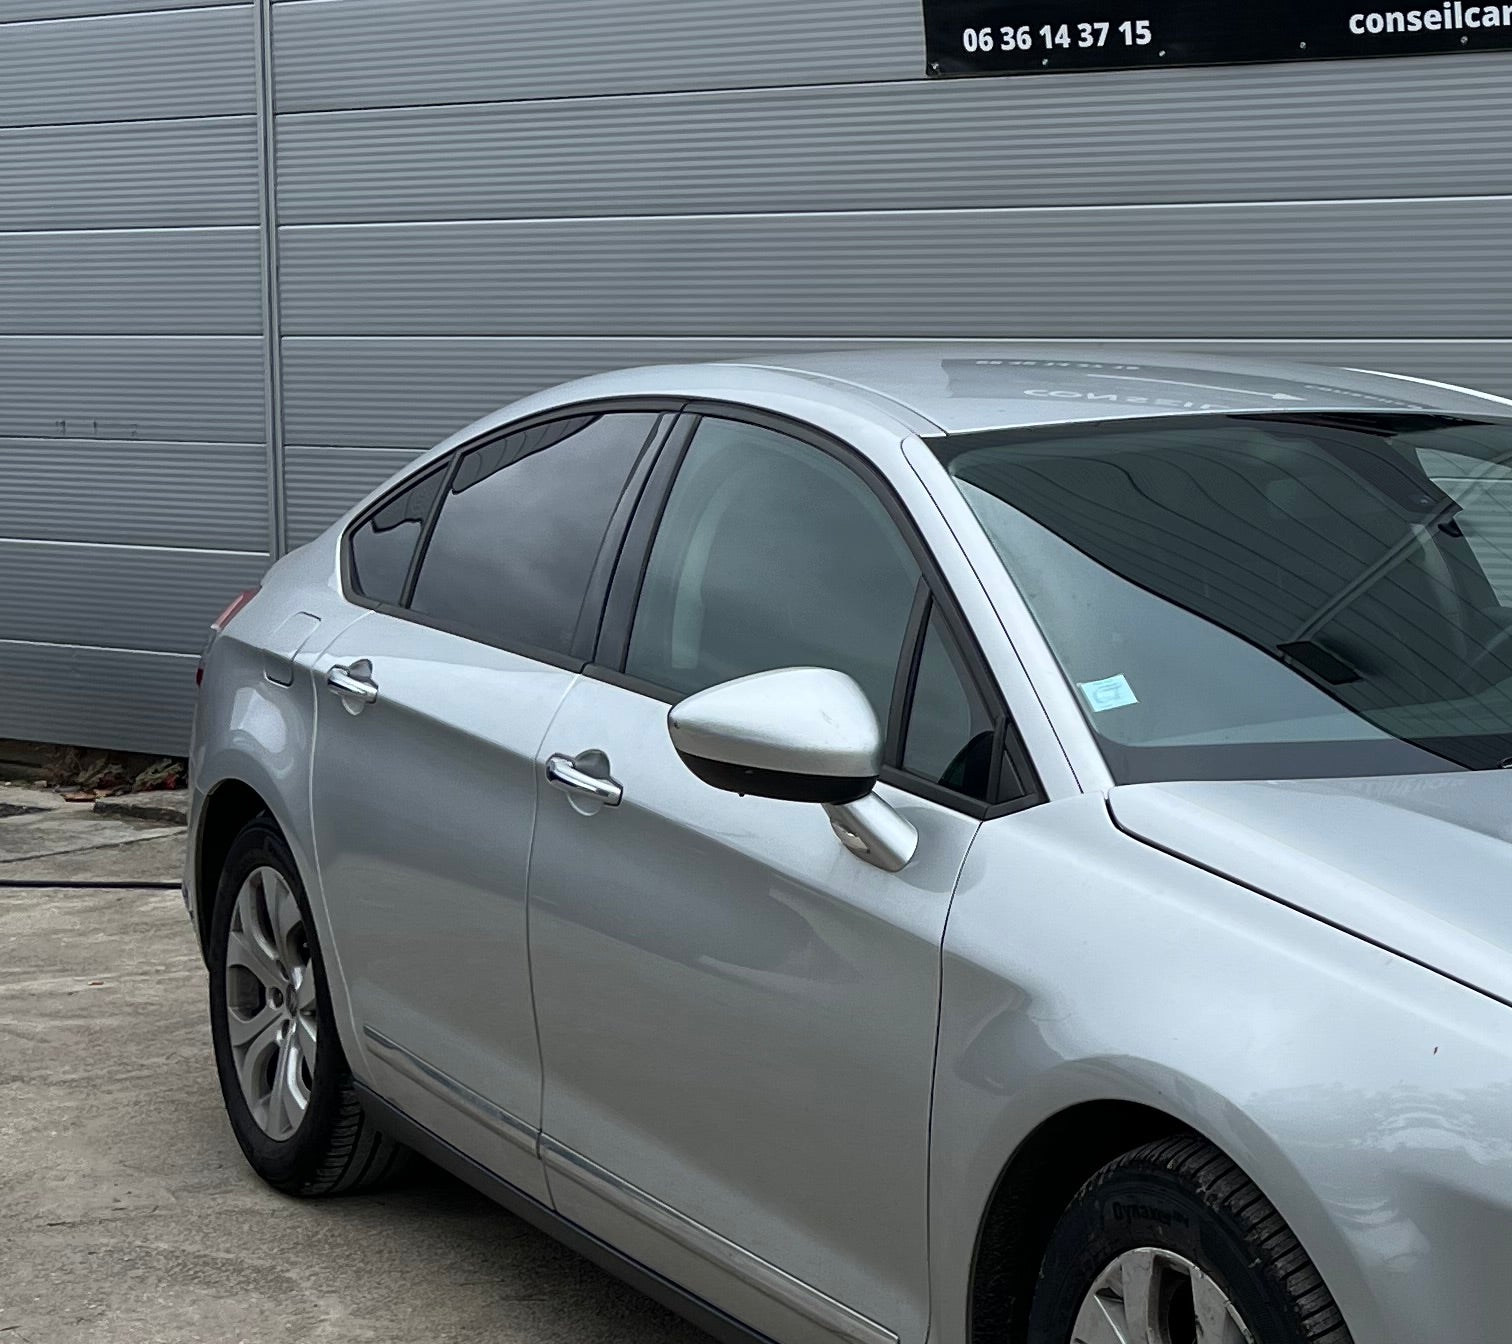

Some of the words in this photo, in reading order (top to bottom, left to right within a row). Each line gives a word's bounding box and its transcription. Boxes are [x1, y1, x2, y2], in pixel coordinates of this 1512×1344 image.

[963, 27, 994, 52] 06
[1000, 25, 1032, 51] 36
[1039, 24, 1071, 49] 14
[1077, 22, 1110, 47] 37
[1118, 20, 1152, 45] 15
